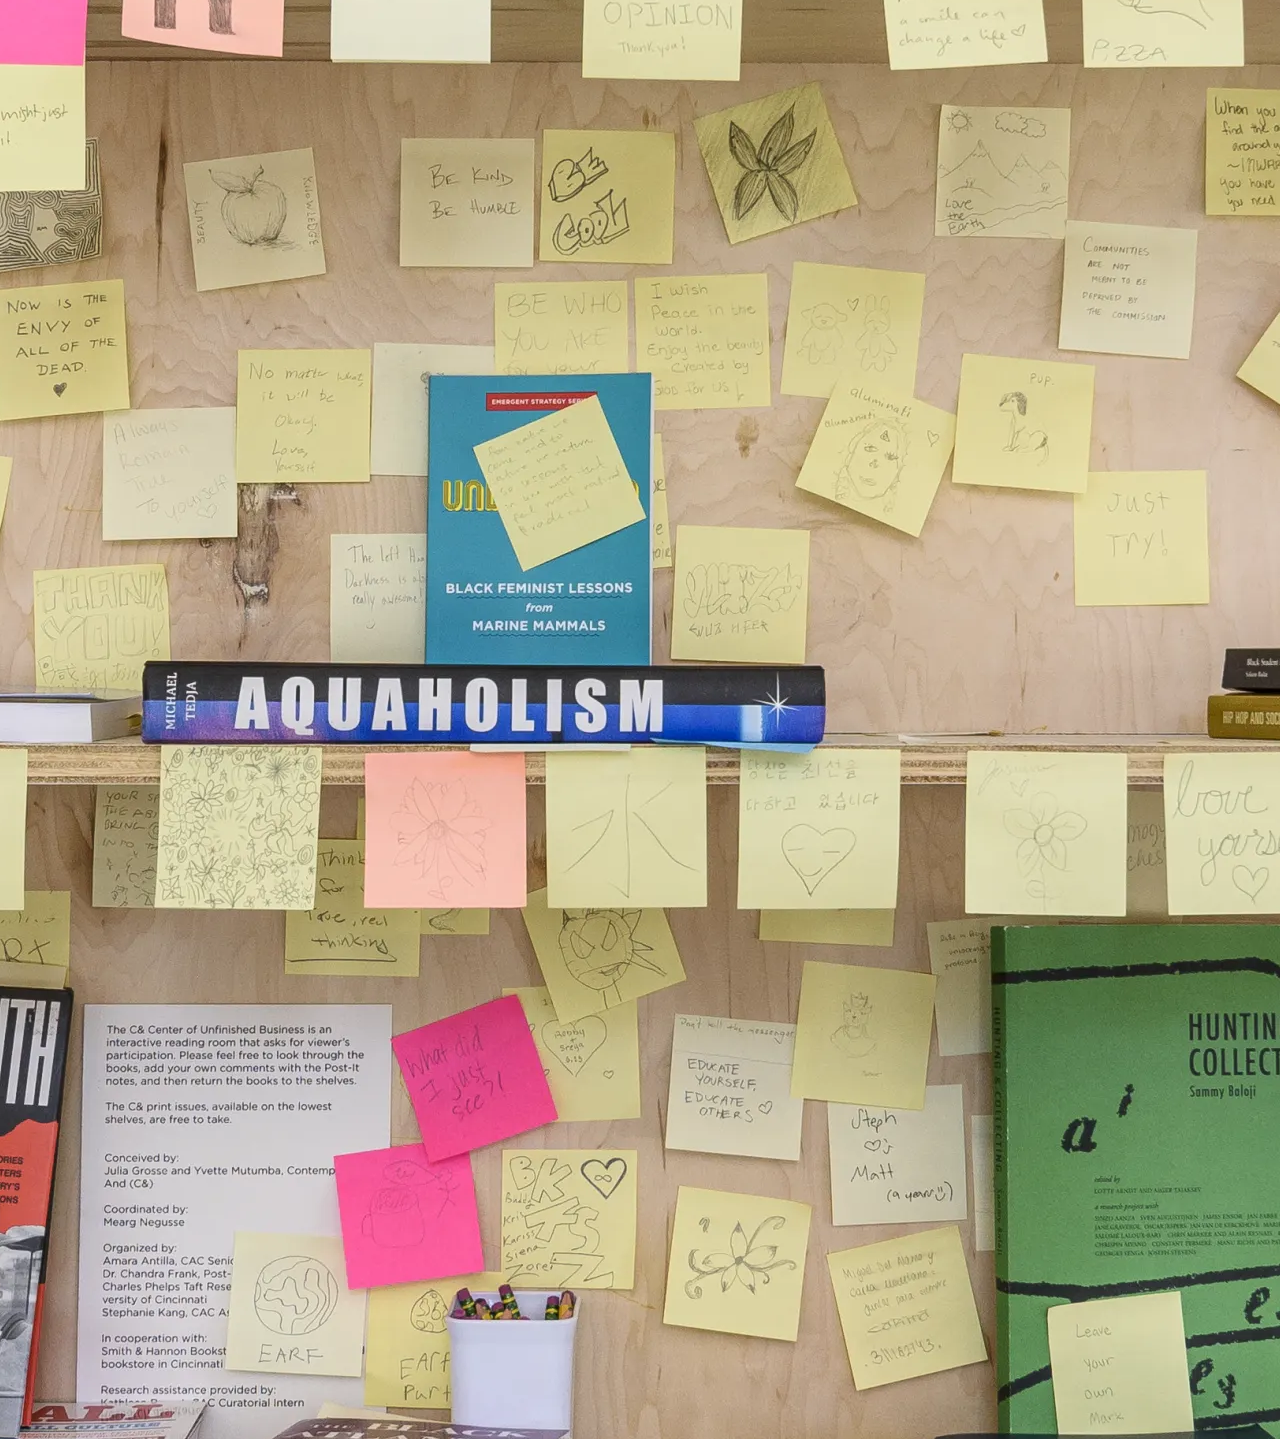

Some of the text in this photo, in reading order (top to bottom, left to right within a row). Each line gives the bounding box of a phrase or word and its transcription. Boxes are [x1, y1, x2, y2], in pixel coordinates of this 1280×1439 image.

[7, 294, 108, 314] NOW IS THE
[17, 317, 101, 335] ENVY OF
[16, 338, 118, 358] ALL OF THE
[36, 361, 87, 376] DEAD.
[446, 583, 633, 593] BLACK FEMINIST LESSONS
[525, 603, 553, 612] from
[473, 620, 606, 631] MARINE MAMMALS
[166, 672, 178, 730] MICHAEL
[185, 681, 197, 721] TEDJA
[234, 676, 664, 735] AQUAHOLISM
[1222, 711, 1234, 724] HIP
[1235, 712, 1248, 724] HOP
[1250, 712, 1264, 725] AND
[106, 1025, 126, 1034] The
[129, 1025, 144, 1034] C&
[148, 1025, 183, 1034] Center
[186, 1025, 196, 1034] of
[200, 1025, 256, 1034] Unfinished
[260, 1025, 304, 1034] Business
[308, 1025, 316, 1034] is
[1190, 1084, 1256, 1099] Sammy Baloji
